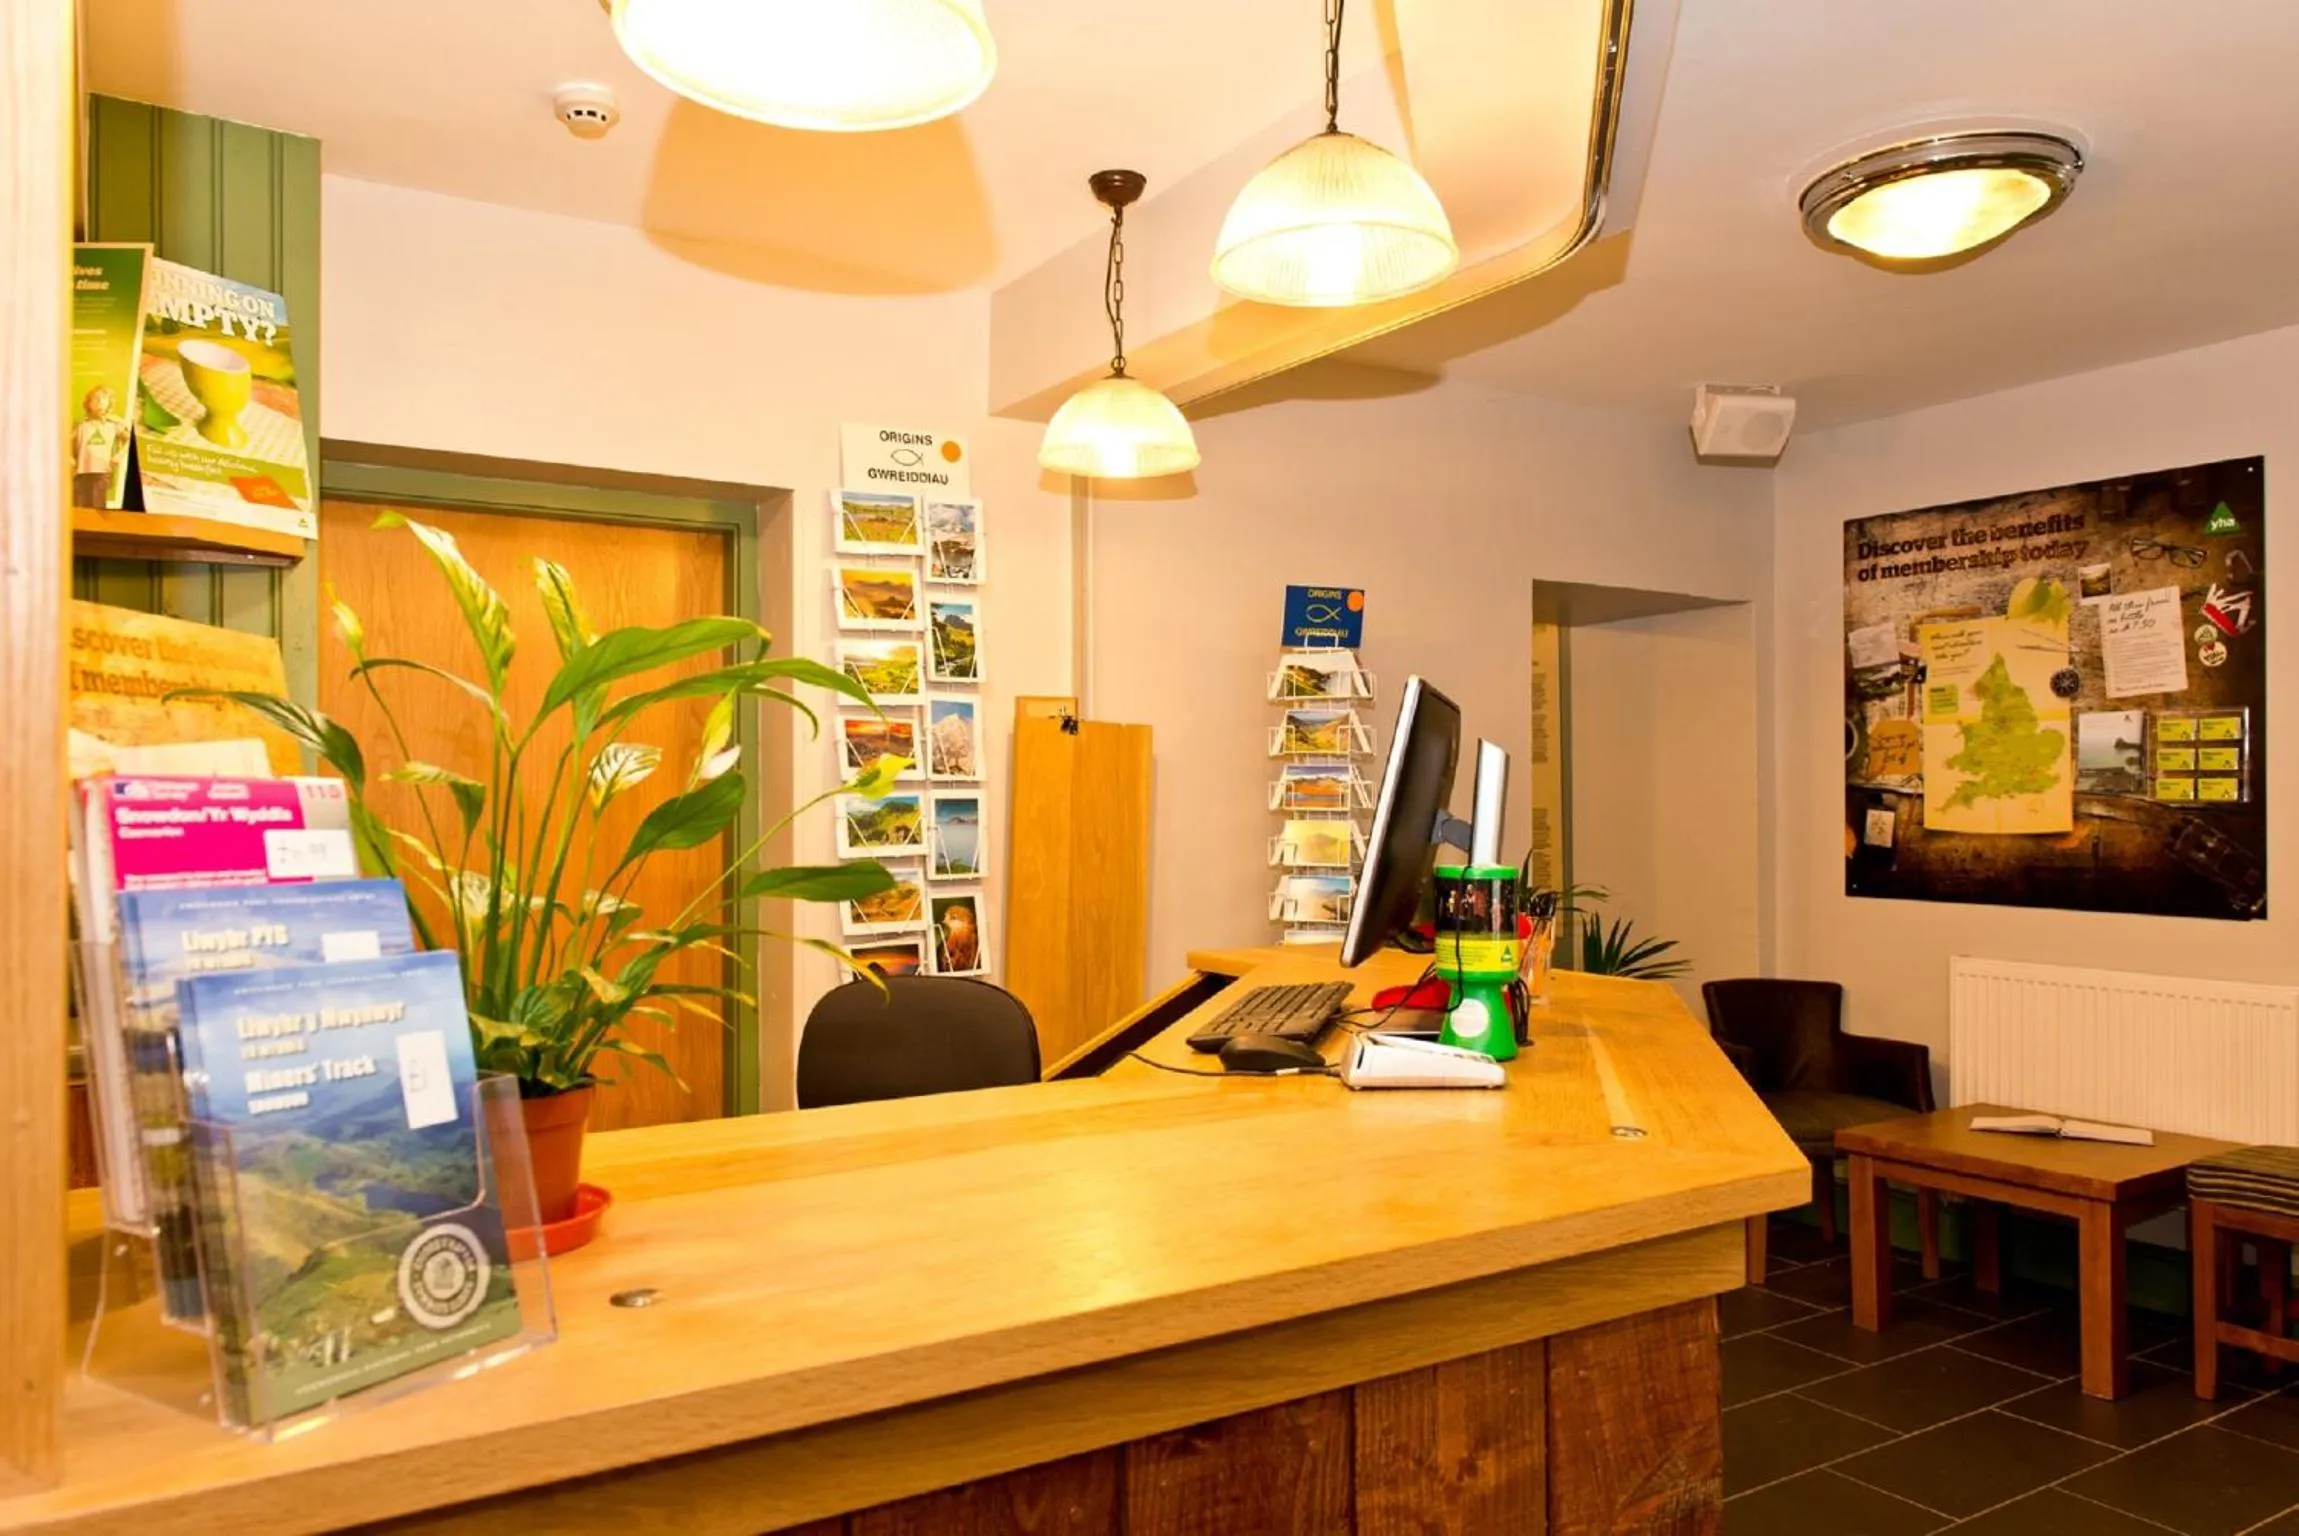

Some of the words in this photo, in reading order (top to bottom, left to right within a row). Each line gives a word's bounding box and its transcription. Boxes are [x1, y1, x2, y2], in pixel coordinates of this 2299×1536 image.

[879, 430, 933, 446] ORIGINS
[867, 467, 949, 486] GWREIDDIAU
[2210, 516, 2236, 531] yha
[1857, 534, 1948, 560] Discover
[1952, 527, 1989, 546] the
[1991, 513, 2086, 542] benefits
[1857, 562, 1878, 582] of
[1880, 547, 2016, 578] membership
[2021, 539, 2090, 563] today
[324, 1055, 377, 1080] Track
